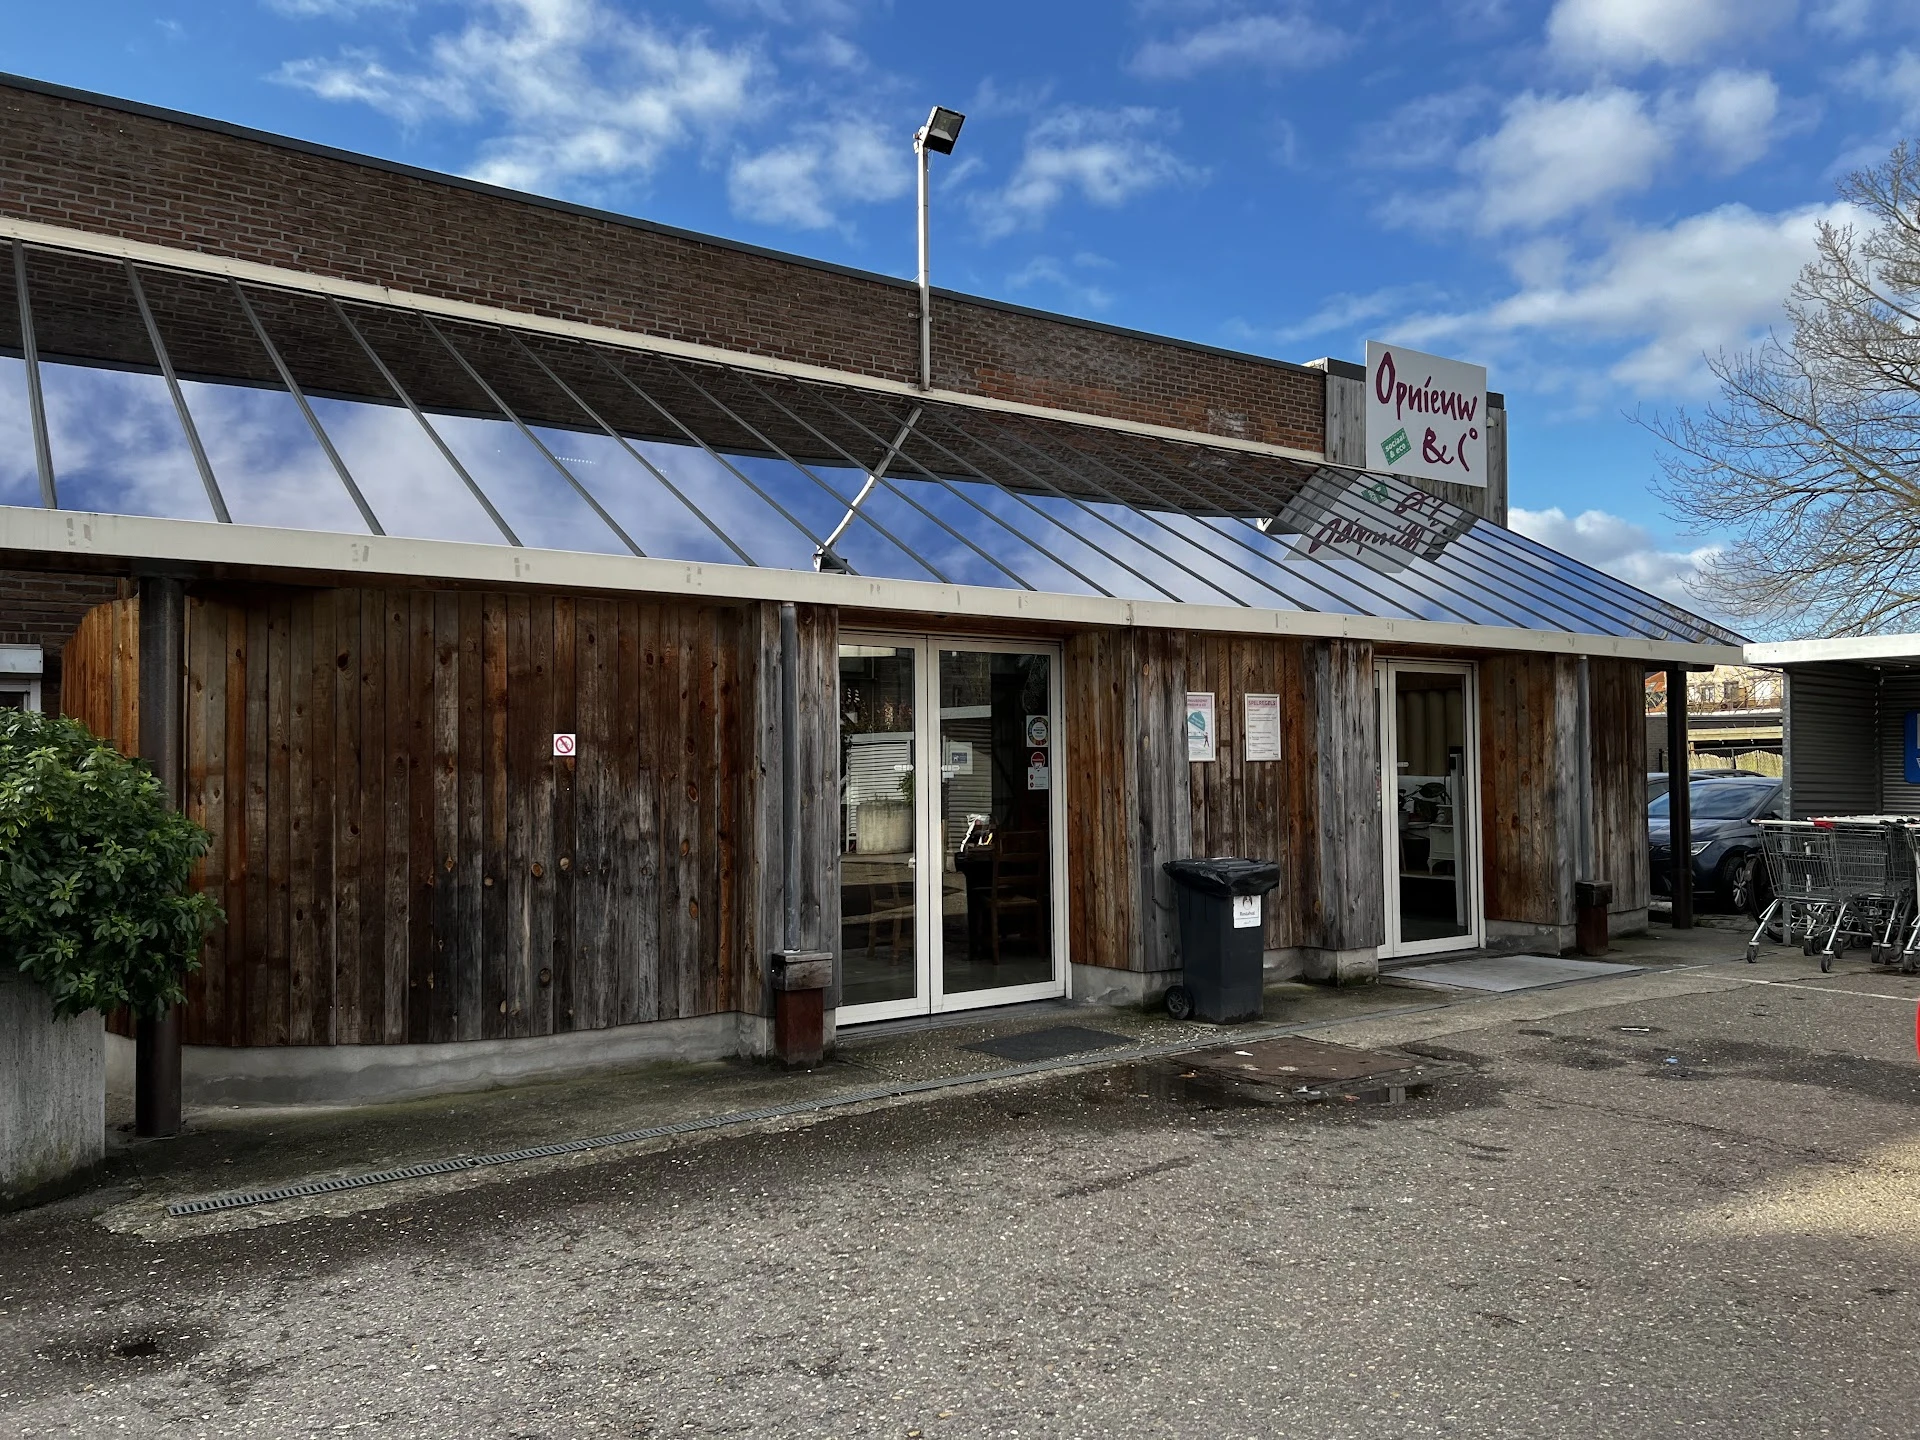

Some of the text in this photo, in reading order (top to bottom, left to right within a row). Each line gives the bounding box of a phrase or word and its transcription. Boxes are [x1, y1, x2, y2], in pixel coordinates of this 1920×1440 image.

[1376, 351, 1478, 421] Opnieuw
[1385, 432, 1406, 452] sociaal
[1395, 443, 1406, 454] eco
[1422, 427, 1455, 465] &
